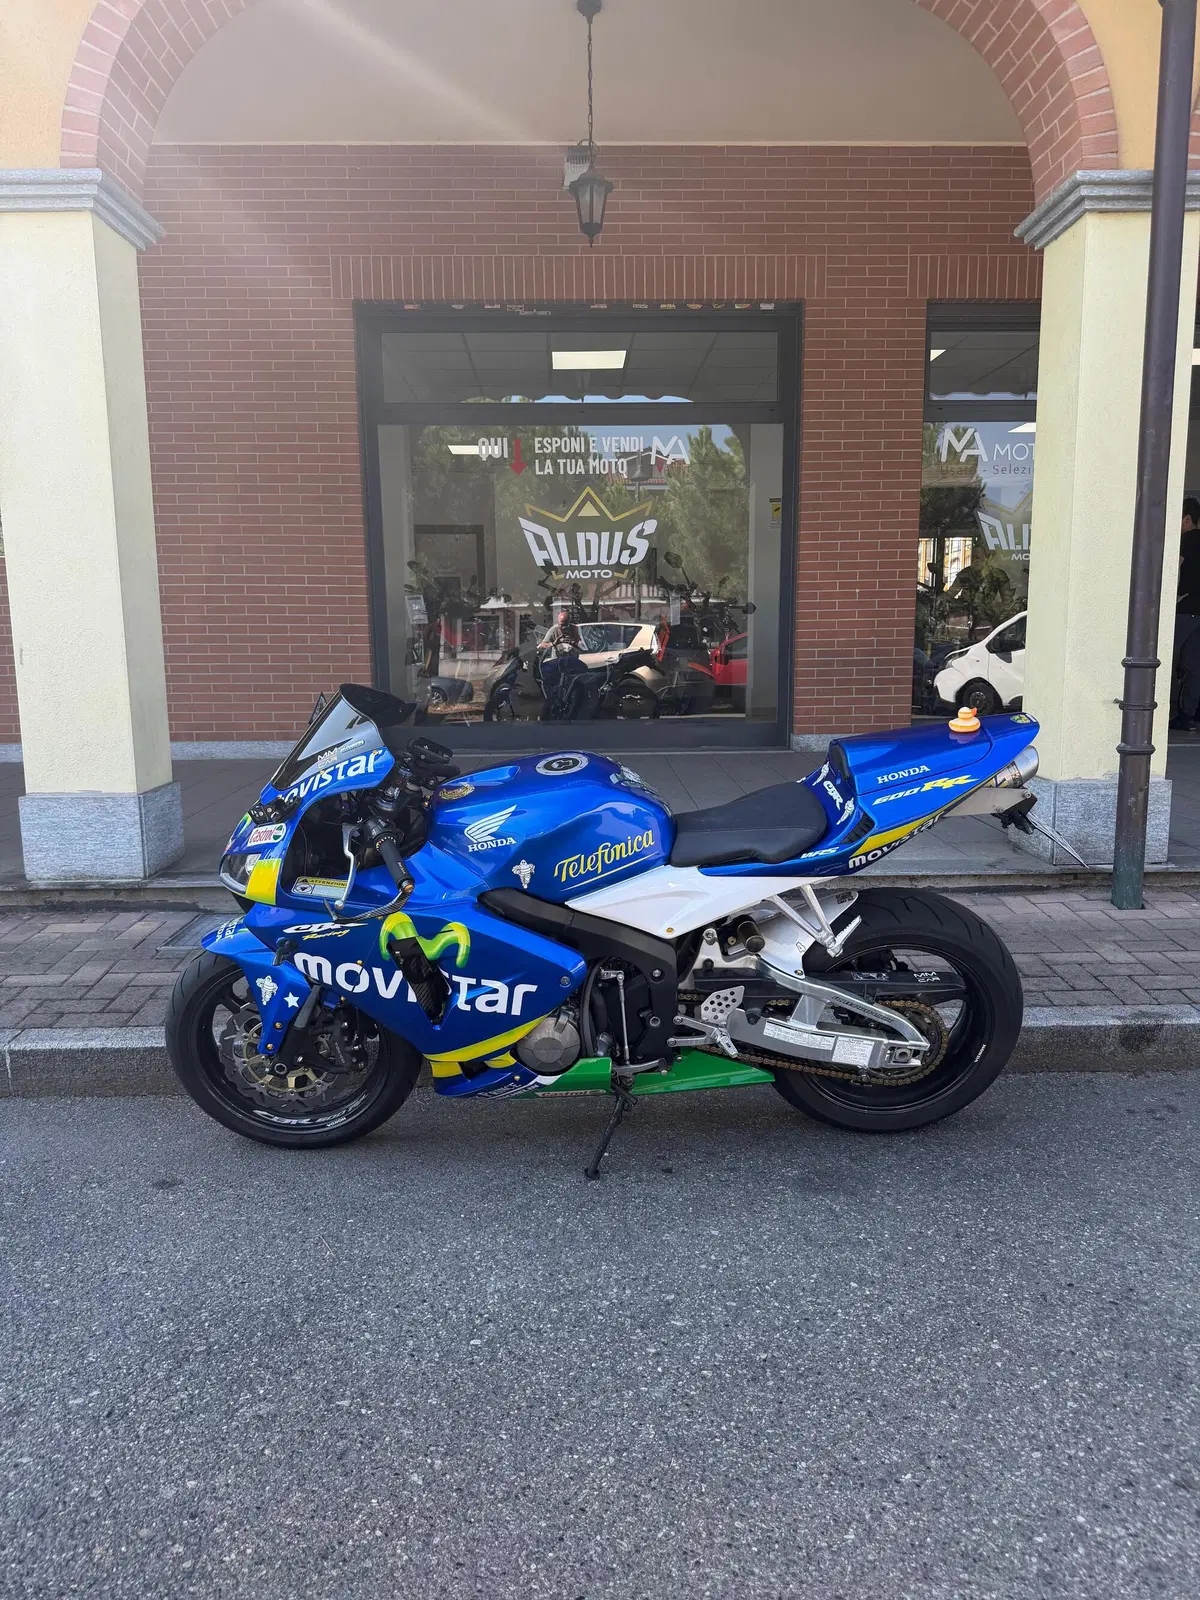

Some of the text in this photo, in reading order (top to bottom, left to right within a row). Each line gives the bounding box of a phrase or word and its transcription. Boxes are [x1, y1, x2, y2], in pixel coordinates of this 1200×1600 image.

[478, 437, 508, 461] QUI
[534, 436, 644, 453] ESPONI E VENDI
[535, 458, 628, 475] LA TUA MOTO
[518, 516, 658, 566] ALDUS
[566, 569, 613, 579] MOTO
[278, 749, 383, 803] ovistar
[877, 764, 931, 785] HONDA
[468, 836, 517, 853] HONDA
[848, 810, 945, 869] movistar
[293, 952, 538, 1016] movtar
